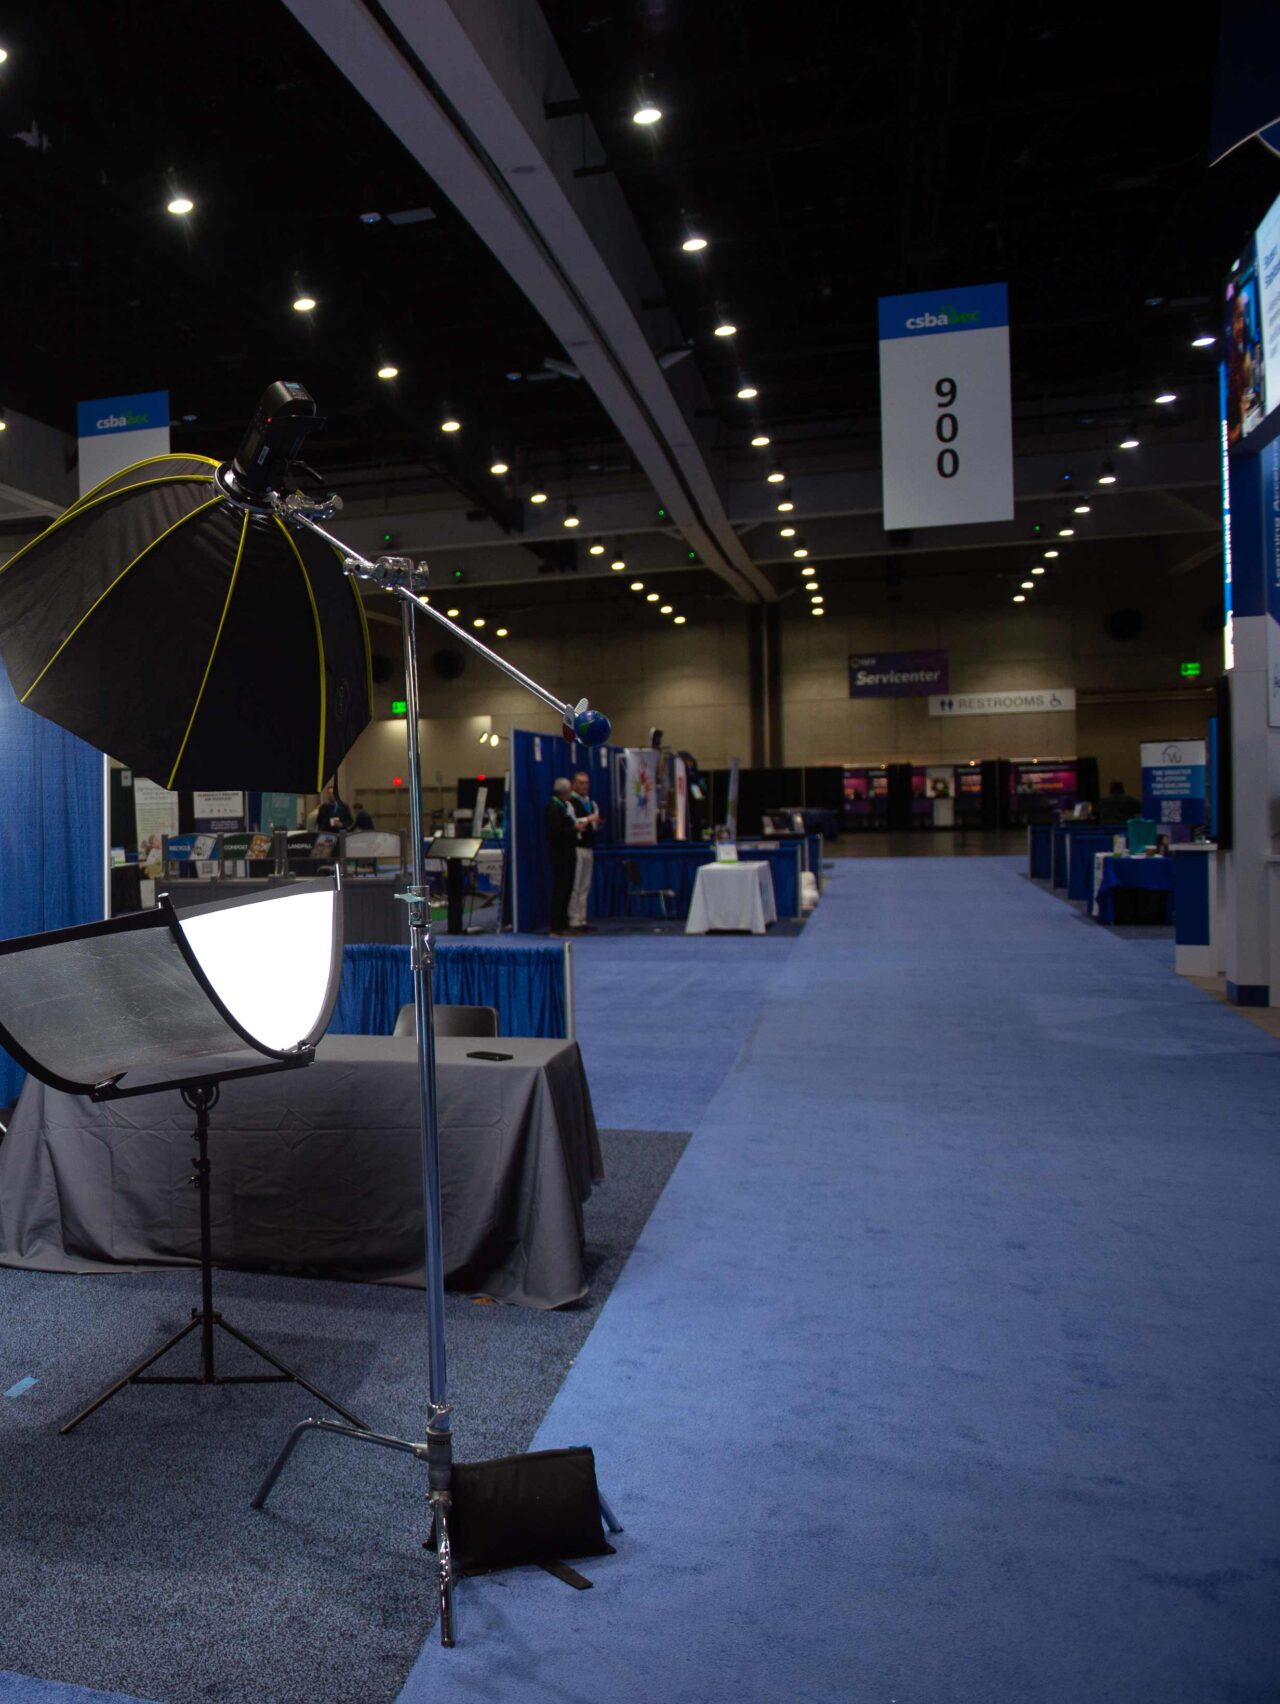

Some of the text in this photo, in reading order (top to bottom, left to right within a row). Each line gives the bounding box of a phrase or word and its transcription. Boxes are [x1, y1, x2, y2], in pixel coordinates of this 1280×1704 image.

[935, 377, 960, 478] 900
[856, 670, 941, 686] Servicenter
[958, 695, 1045, 709] RESTROOMS
